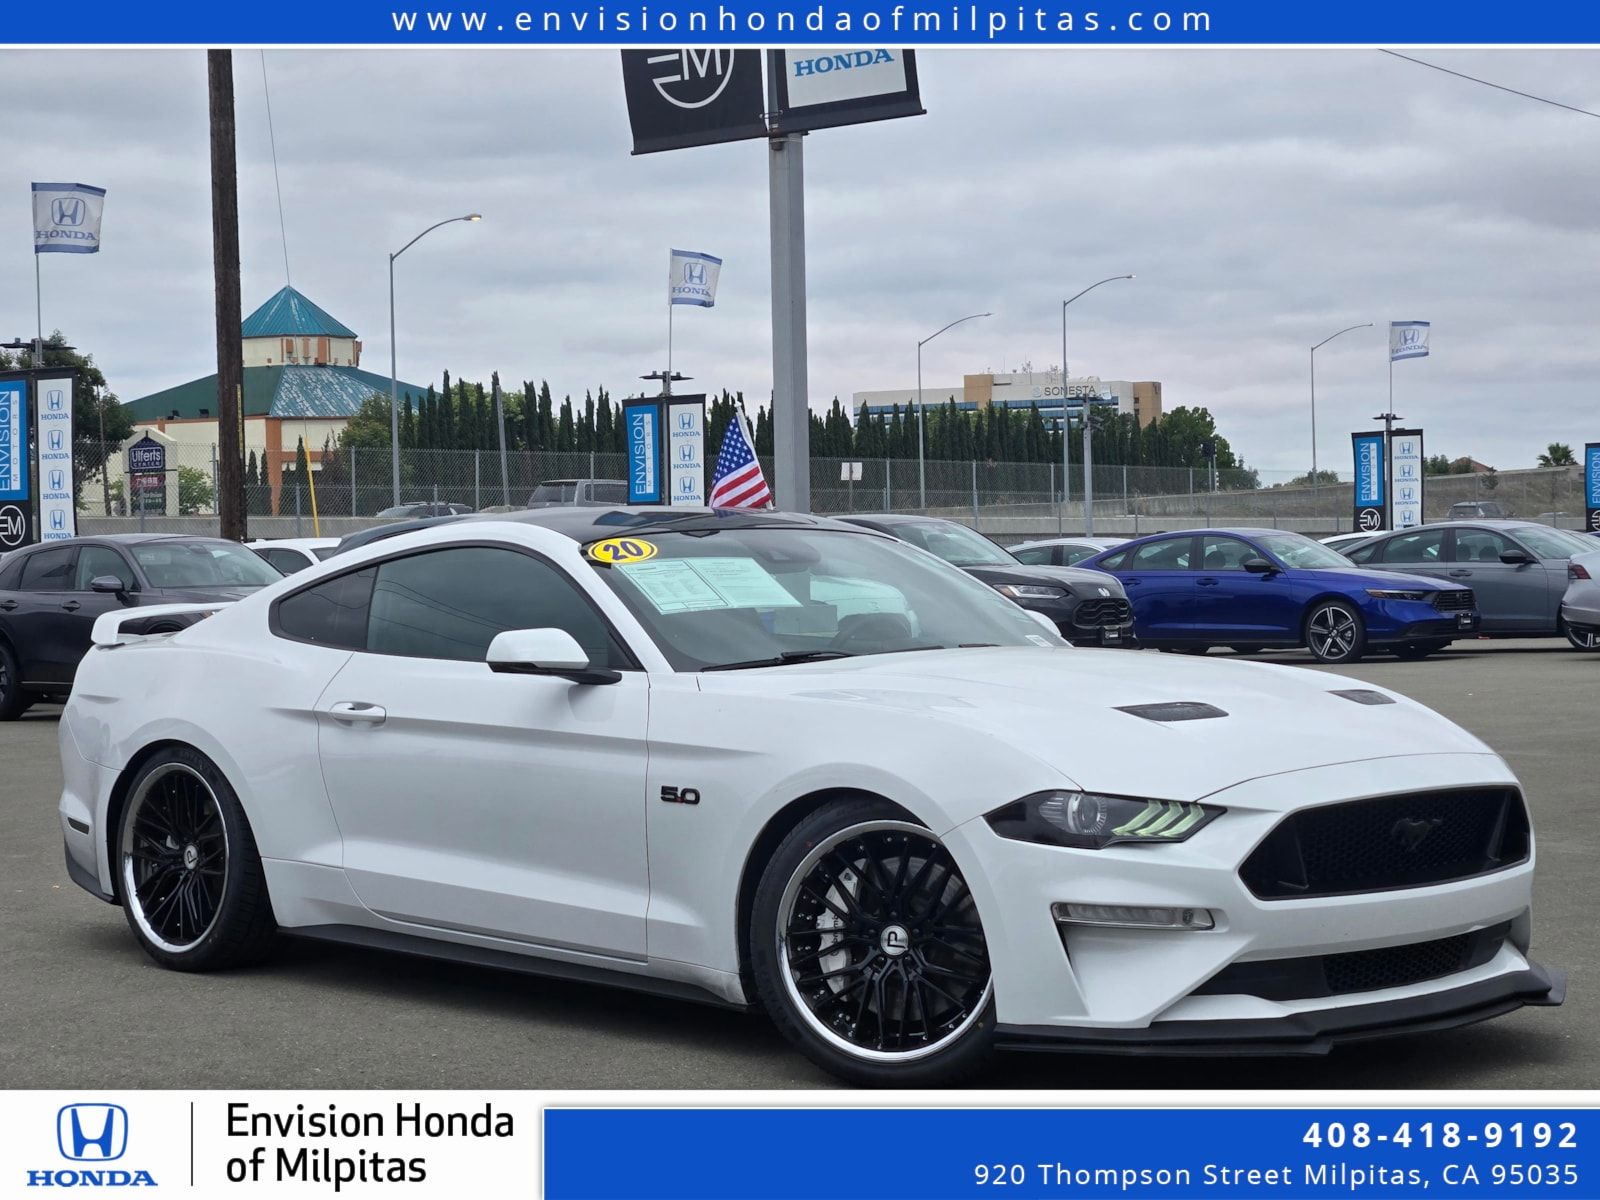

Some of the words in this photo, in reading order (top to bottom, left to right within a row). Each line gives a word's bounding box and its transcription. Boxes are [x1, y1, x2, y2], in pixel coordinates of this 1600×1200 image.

[793, 48, 895, 77] HONDA
[37, 230, 96, 241] HONDA
[1044, 385, 1096, 396] SONESTA
[41, 413, 69, 421] HONDA
[672, 430, 701, 438] HONDA
[0, 391, 10, 491] ENVISION
[41, 453, 70, 461] HONDA
[132, 450, 161, 461] Ulferts
[632, 413, 646, 495] ENVISION
[1361, 442, 1370, 502] ENVISION
[42, 492, 71, 501] HONDA
[43, 532, 72, 540] HONDA
[603, 541, 644, 561] 20
[660, 785, 700, 805] 5.0
